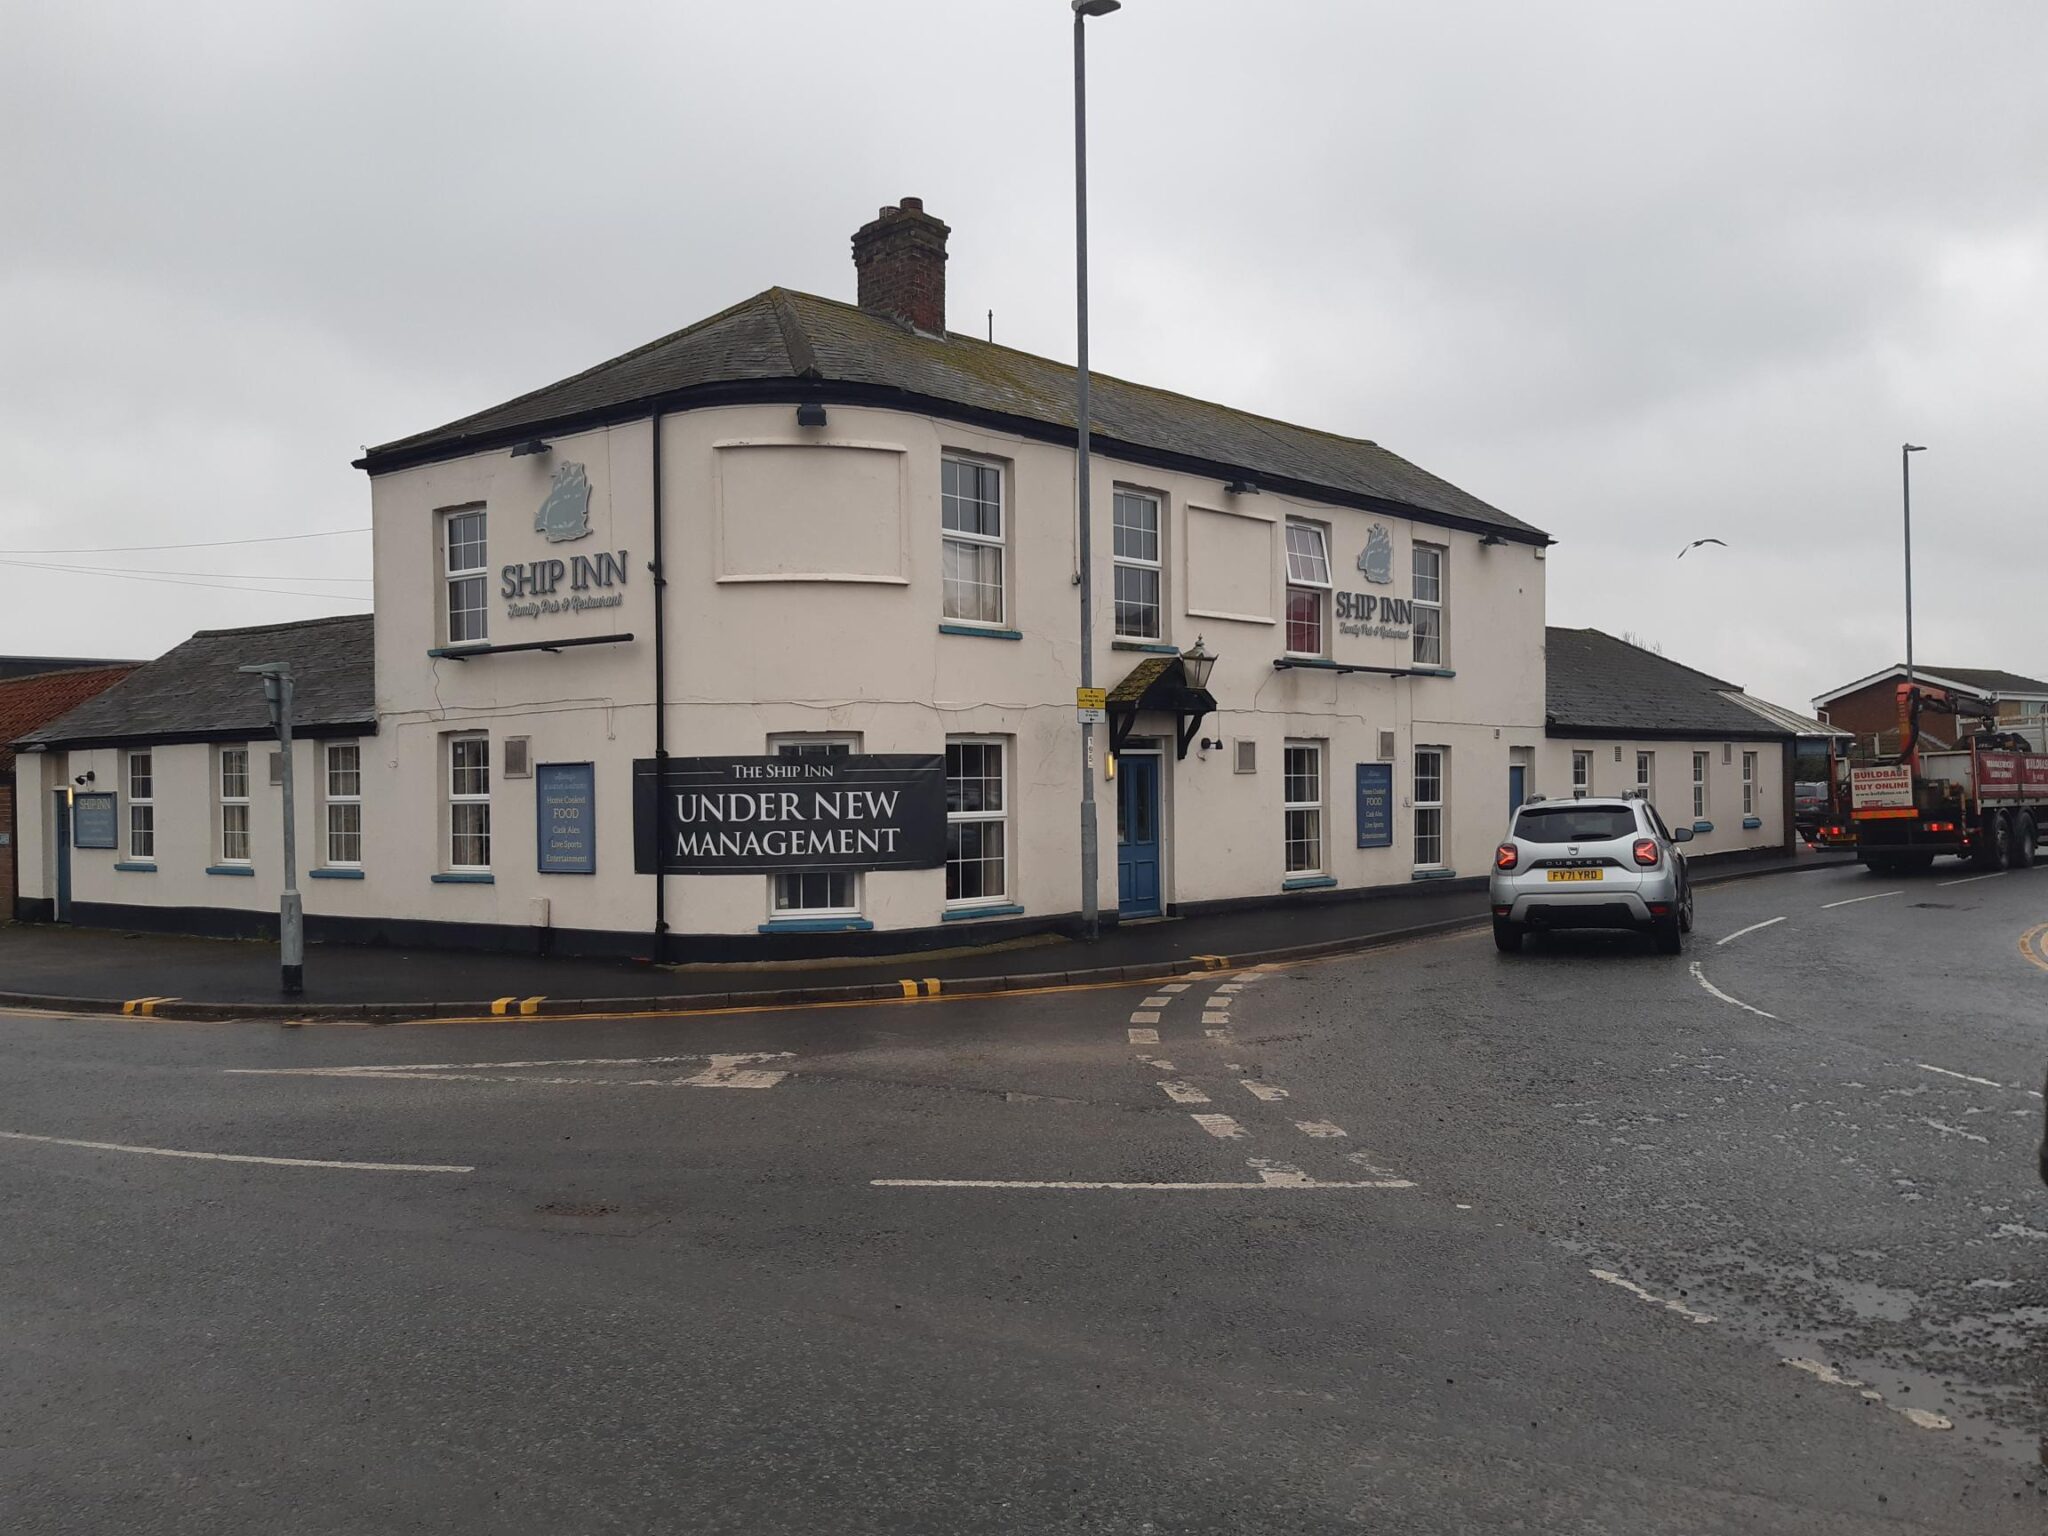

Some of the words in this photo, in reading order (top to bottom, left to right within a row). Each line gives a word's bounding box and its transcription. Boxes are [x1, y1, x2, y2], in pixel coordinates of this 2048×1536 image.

[501, 559, 565, 598] SHIP
[570, 550, 628, 590] INN
[508, 603, 540, 619] Family
[540, 599, 560, 613] Pub
[571, 592, 623, 614] Restaurant
[1336, 591, 1378, 621] SHIP
[1379, 596, 1413, 625] INN
[766, 763, 801, 778] SHIP
[804, 763, 834, 777] INN
[1875, 782, 1909, 790] ONLINE
[79, 798, 96, 810] SHIP
[675, 792, 807, 823] UNDER
[813, 790, 901, 820] NEW
[1366, 797, 1383, 806] FOOD
[553, 808, 579, 819] FOOD
[675, 828, 901, 856] MANAGEMENT
[1552, 871, 1575, 880] FV71
[1577, 870, 1597, 880] YRD
